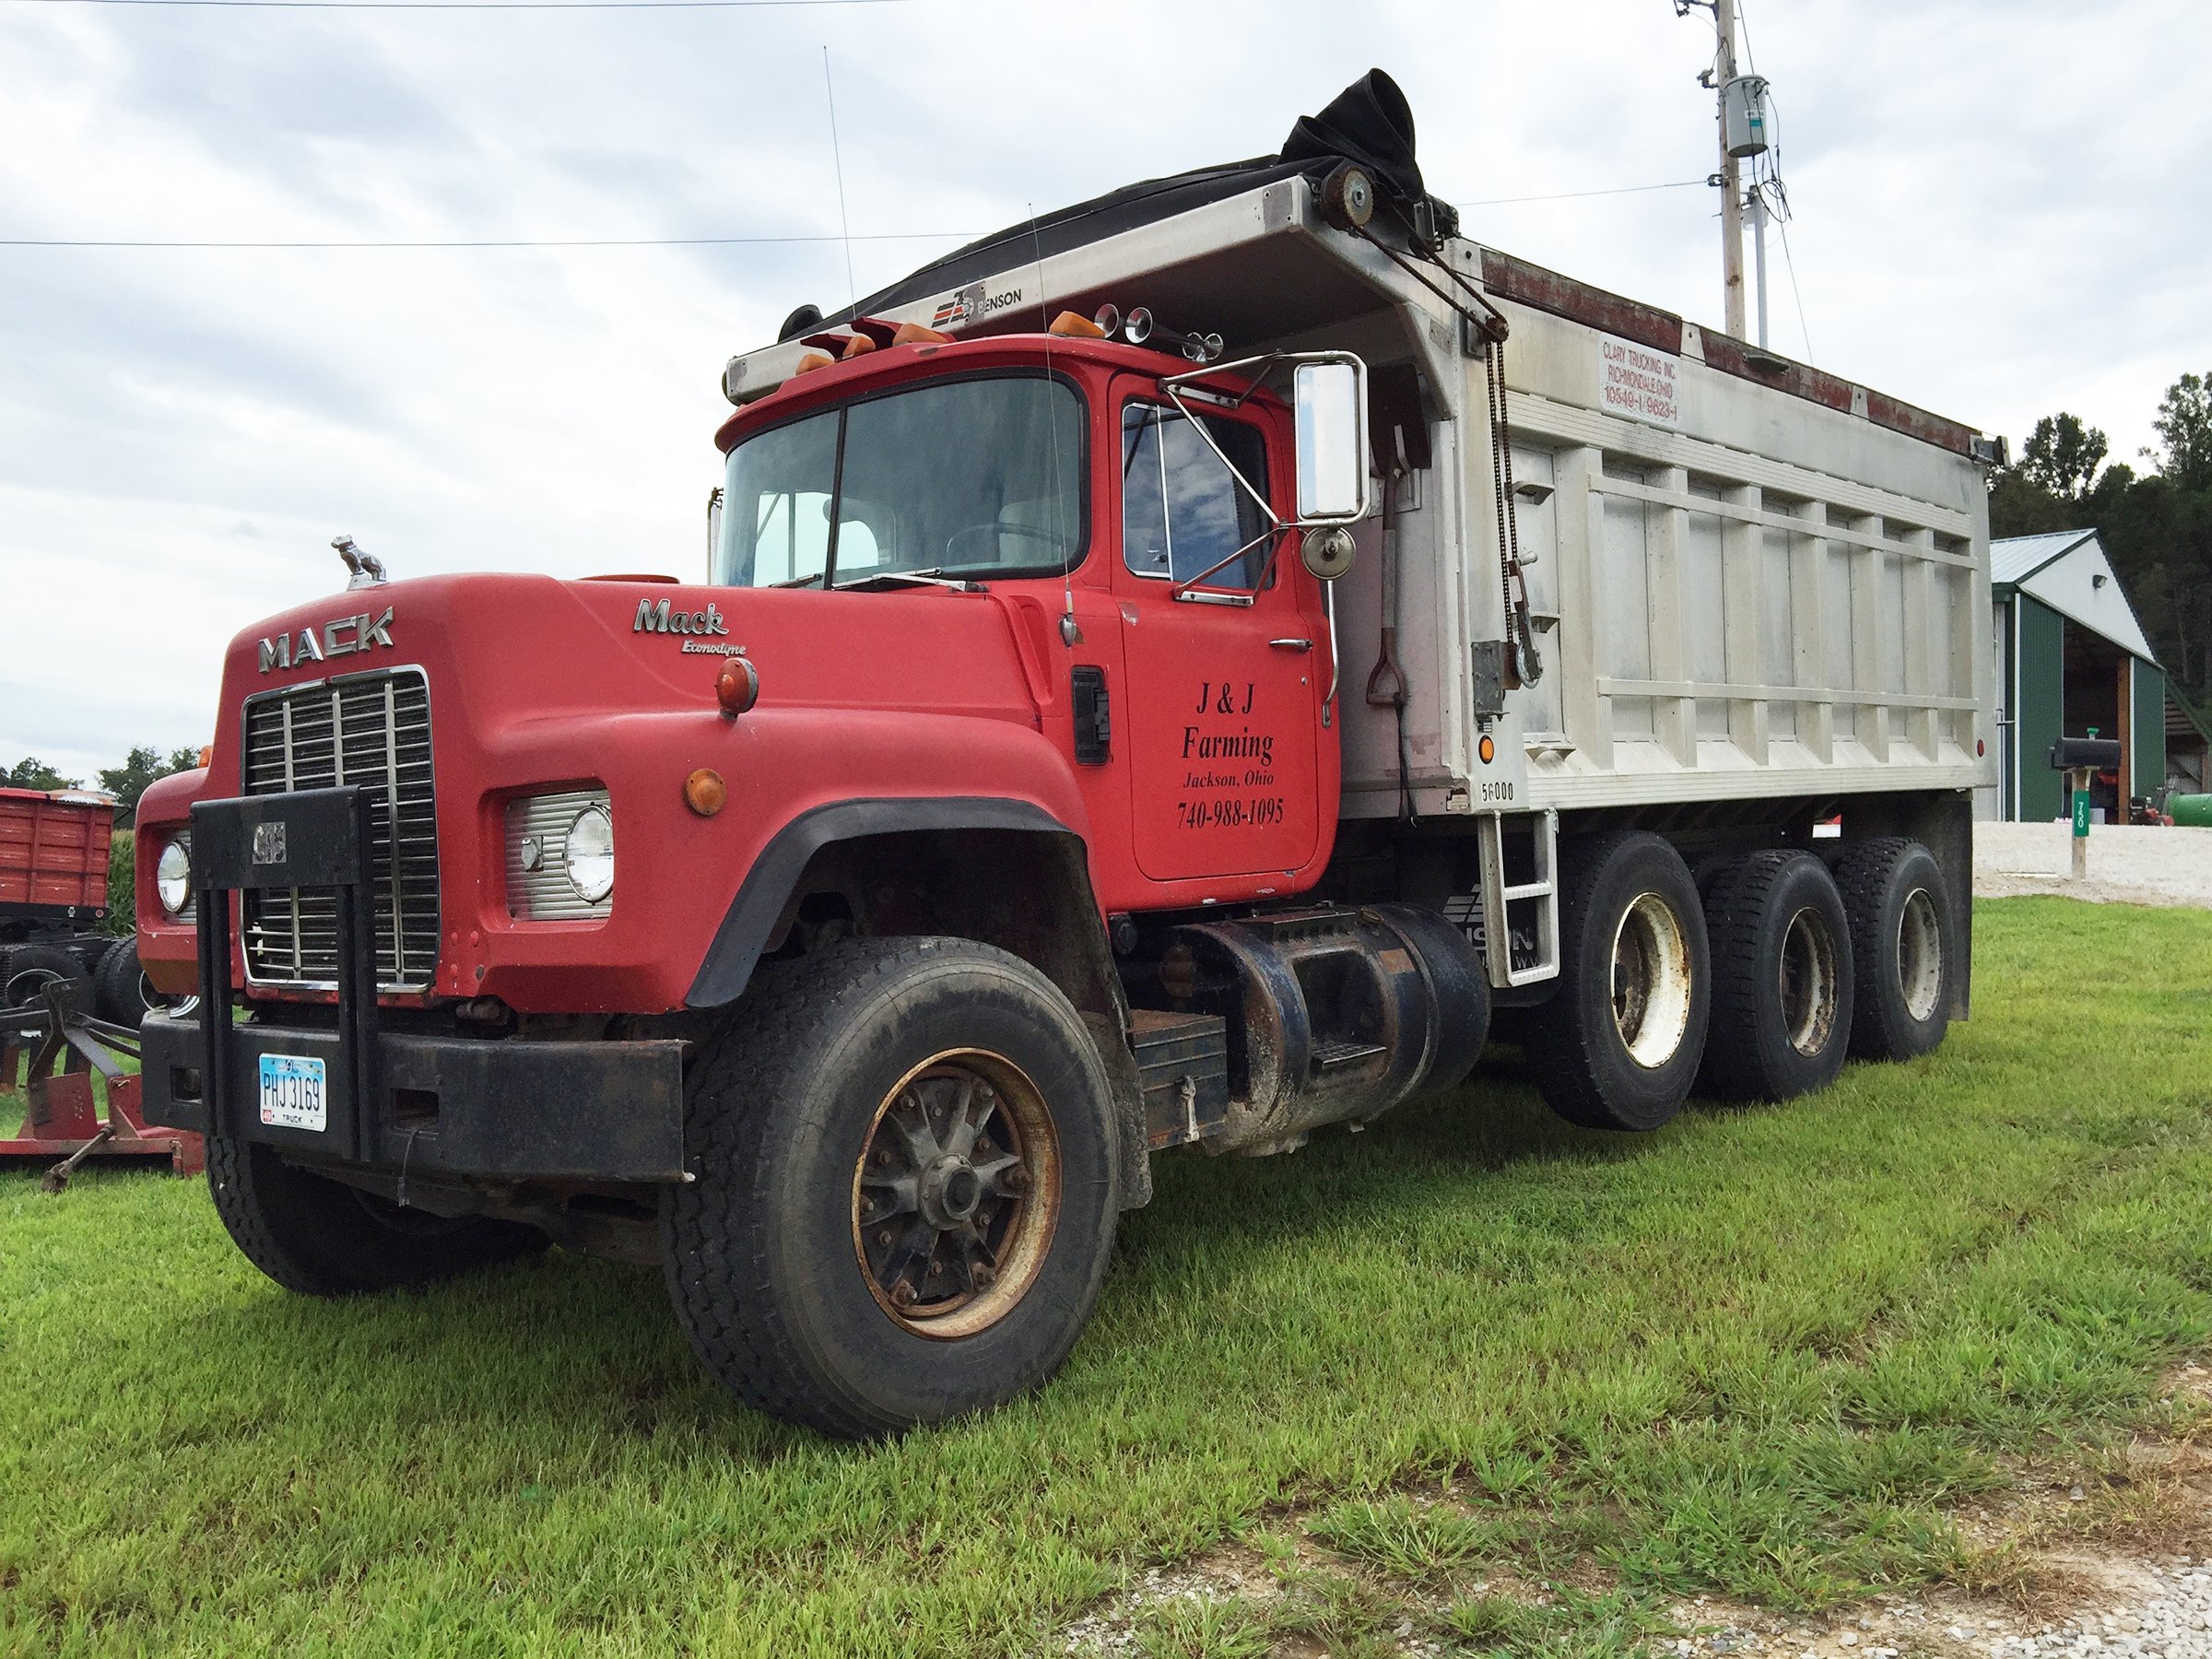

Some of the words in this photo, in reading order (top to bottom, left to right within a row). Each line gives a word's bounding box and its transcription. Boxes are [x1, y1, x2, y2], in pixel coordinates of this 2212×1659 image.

[1603, 341, 1626, 364] CLARY
[1628, 349, 1662, 375] TRUCKING
[633, 598, 729, 635] Mack
[257, 605, 394, 674] MACK
[682, 639, 747, 656] Econodyne
[1196, 682, 1210, 714] J
[1217, 682, 1234, 714] &
[1241, 683, 1254, 714] J
[1181, 726, 1273, 767] Farming
[1182, 771, 1241, 789] Jackson,
[1244, 770, 1274, 786] Ohio
[1481, 782, 1513, 802] 56000
[1177, 798, 1284, 829] 740-988-1095
[264, 1072, 287, 1108] PHJ
[289, 1076, 320, 1112] 3169
